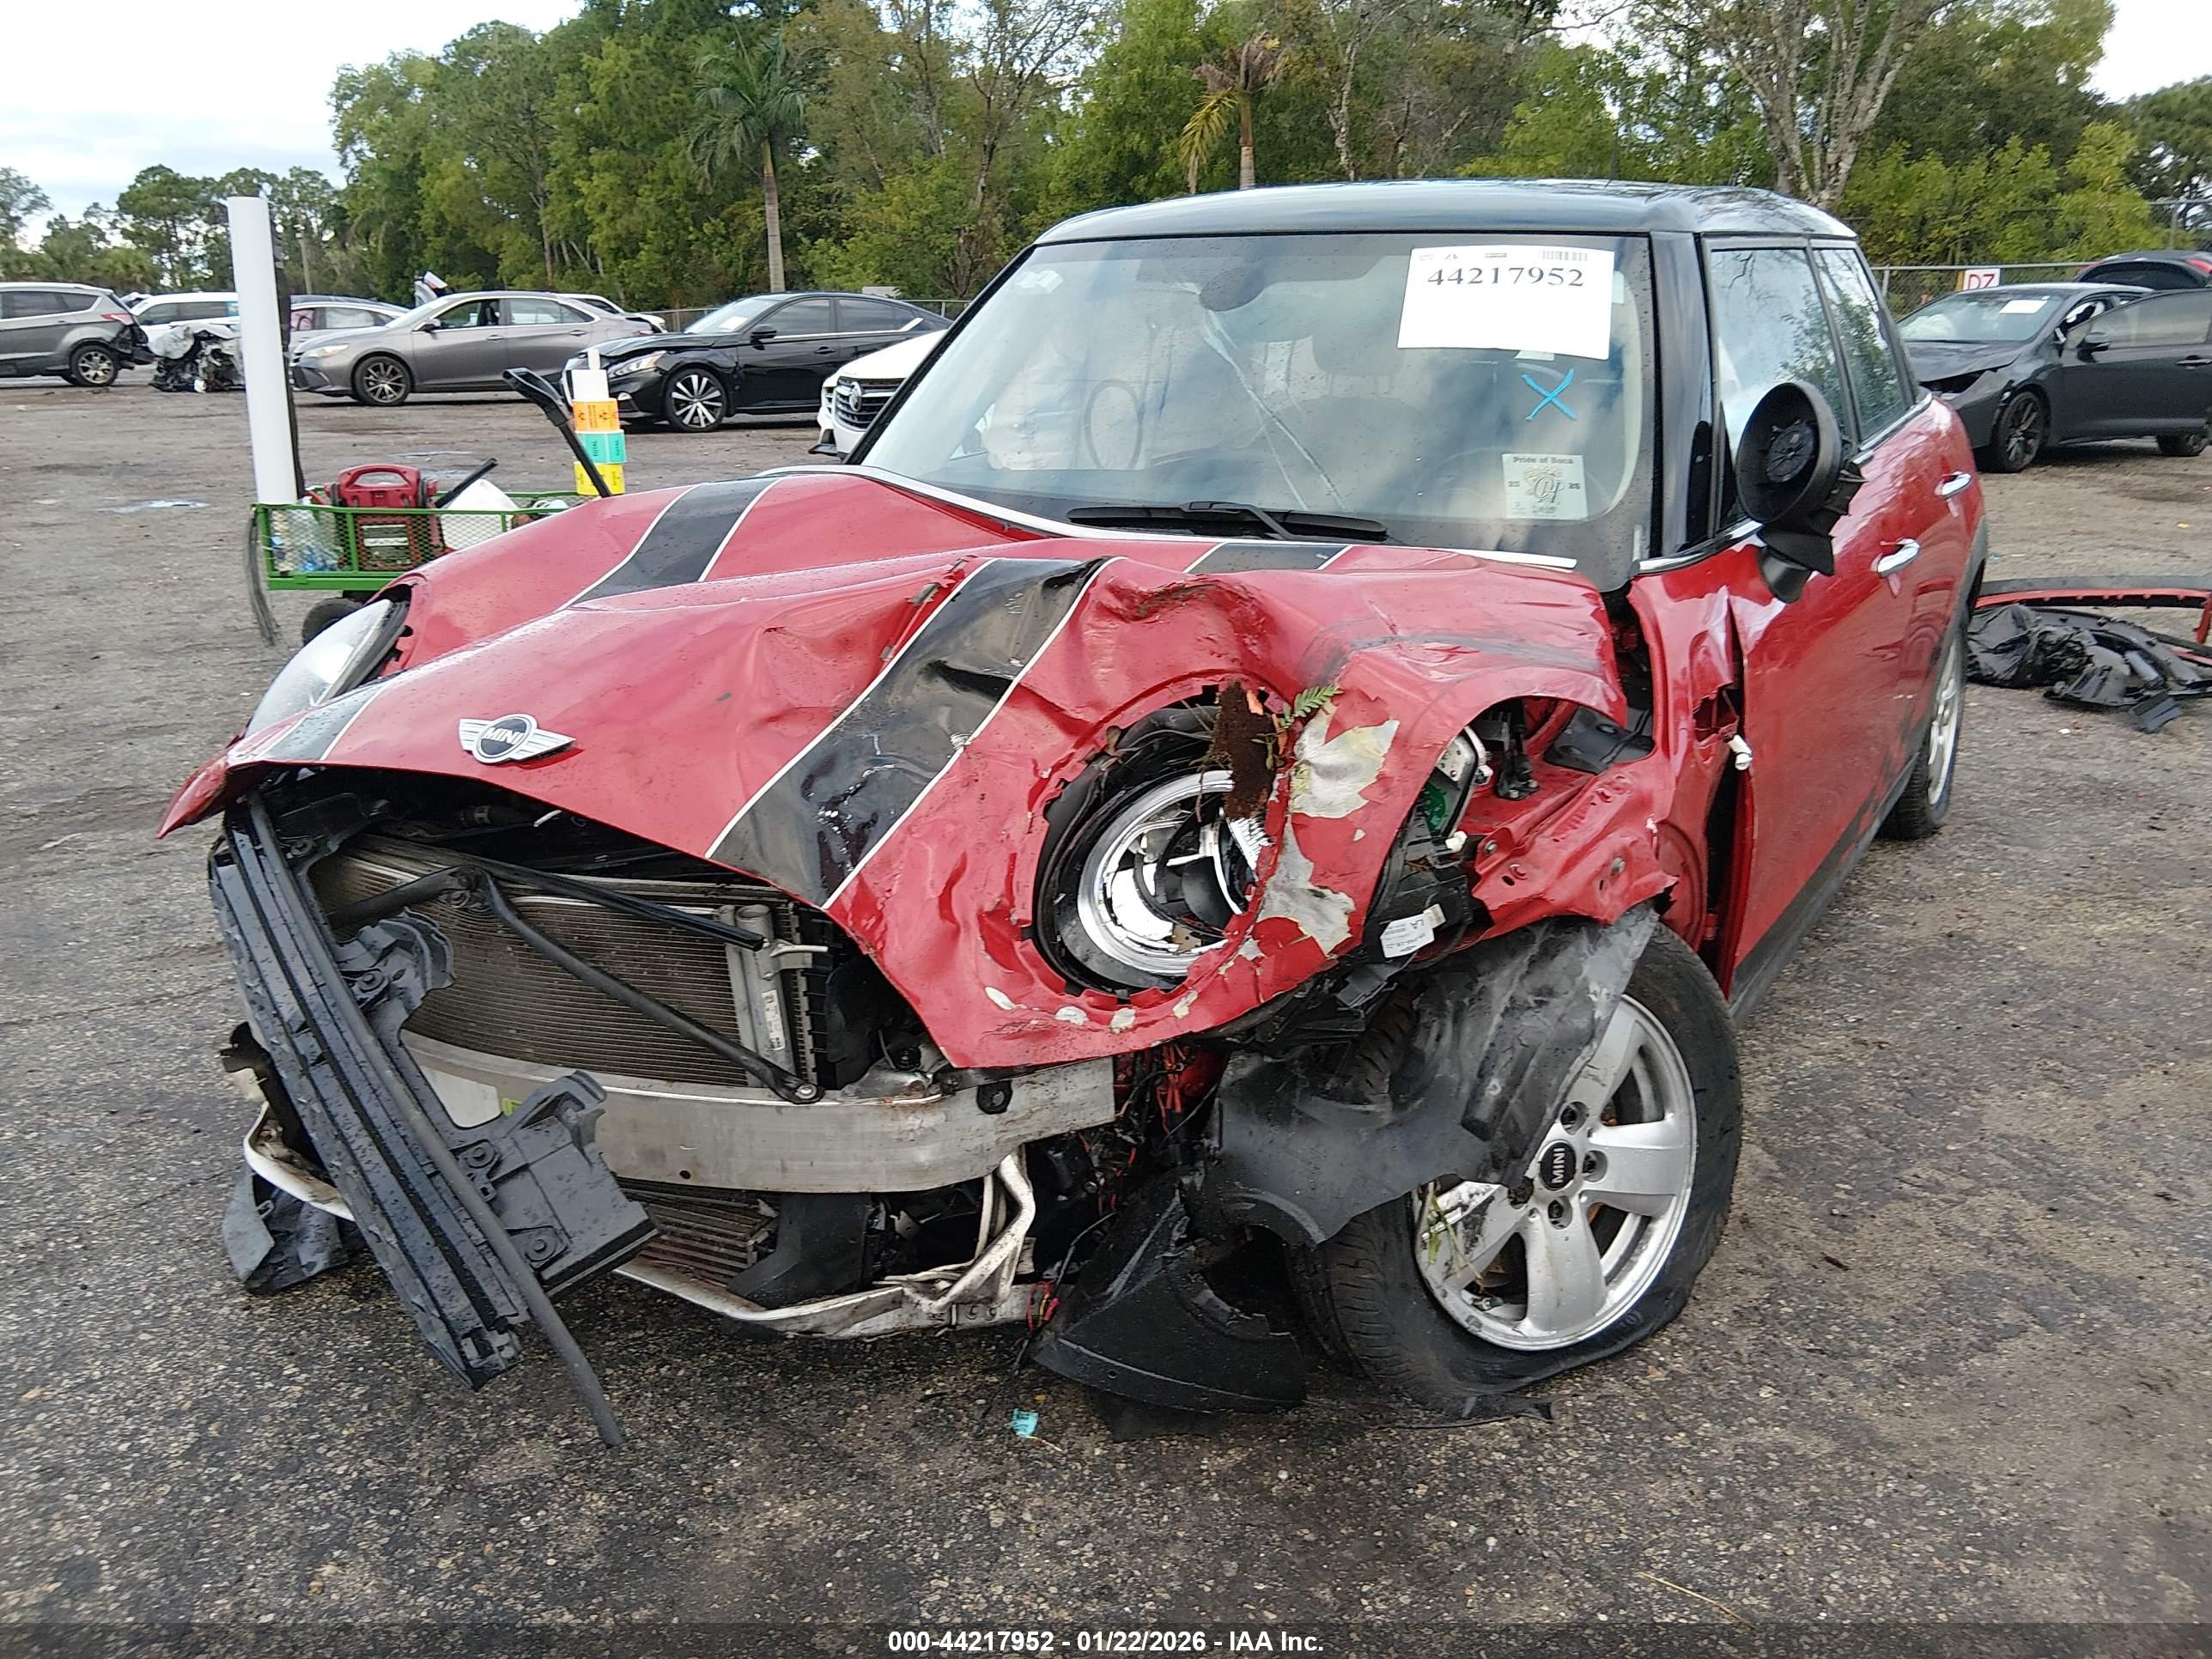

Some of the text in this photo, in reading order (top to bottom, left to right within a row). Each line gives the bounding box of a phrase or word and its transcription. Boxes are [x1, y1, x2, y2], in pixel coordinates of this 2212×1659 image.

[1427, 266, 1584, 287] 44217952
[482, 726, 526, 745] MINI
[1552, 1147, 1566, 1184] MINI
